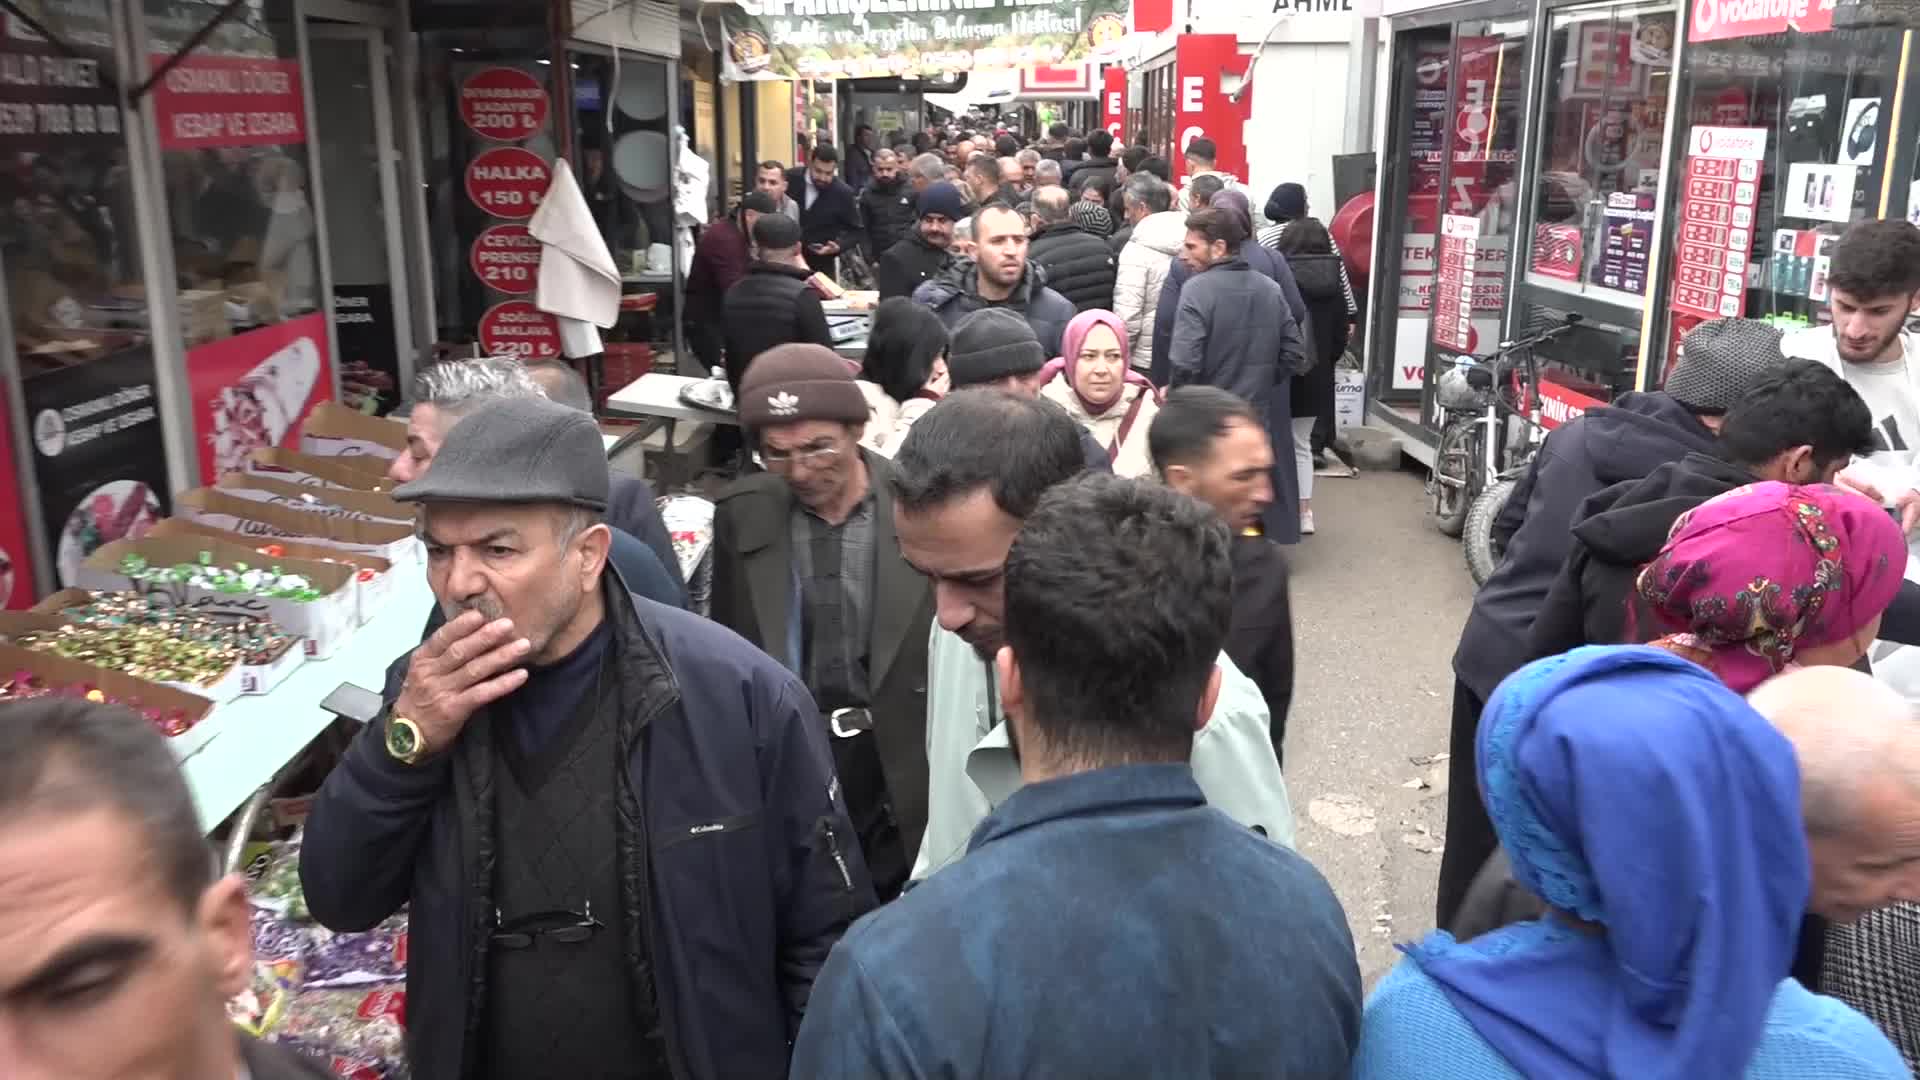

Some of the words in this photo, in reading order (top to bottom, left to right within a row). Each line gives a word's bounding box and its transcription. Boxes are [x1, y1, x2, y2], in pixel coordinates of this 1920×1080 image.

[1720, 0, 1808, 24] vodafone
[165, 68, 239, 94] OSMANLI
[241, 64, 289, 94] DÖNER
[174, 113, 224, 138] KEBAP
[226, 113, 247, 136] VE
[472, 113, 514, 129] 200
[472, 166, 546, 180] HALKA
[480, 191, 522, 205] 150
[485, 266, 528, 281] 210
[491, 342, 533, 356] 220
